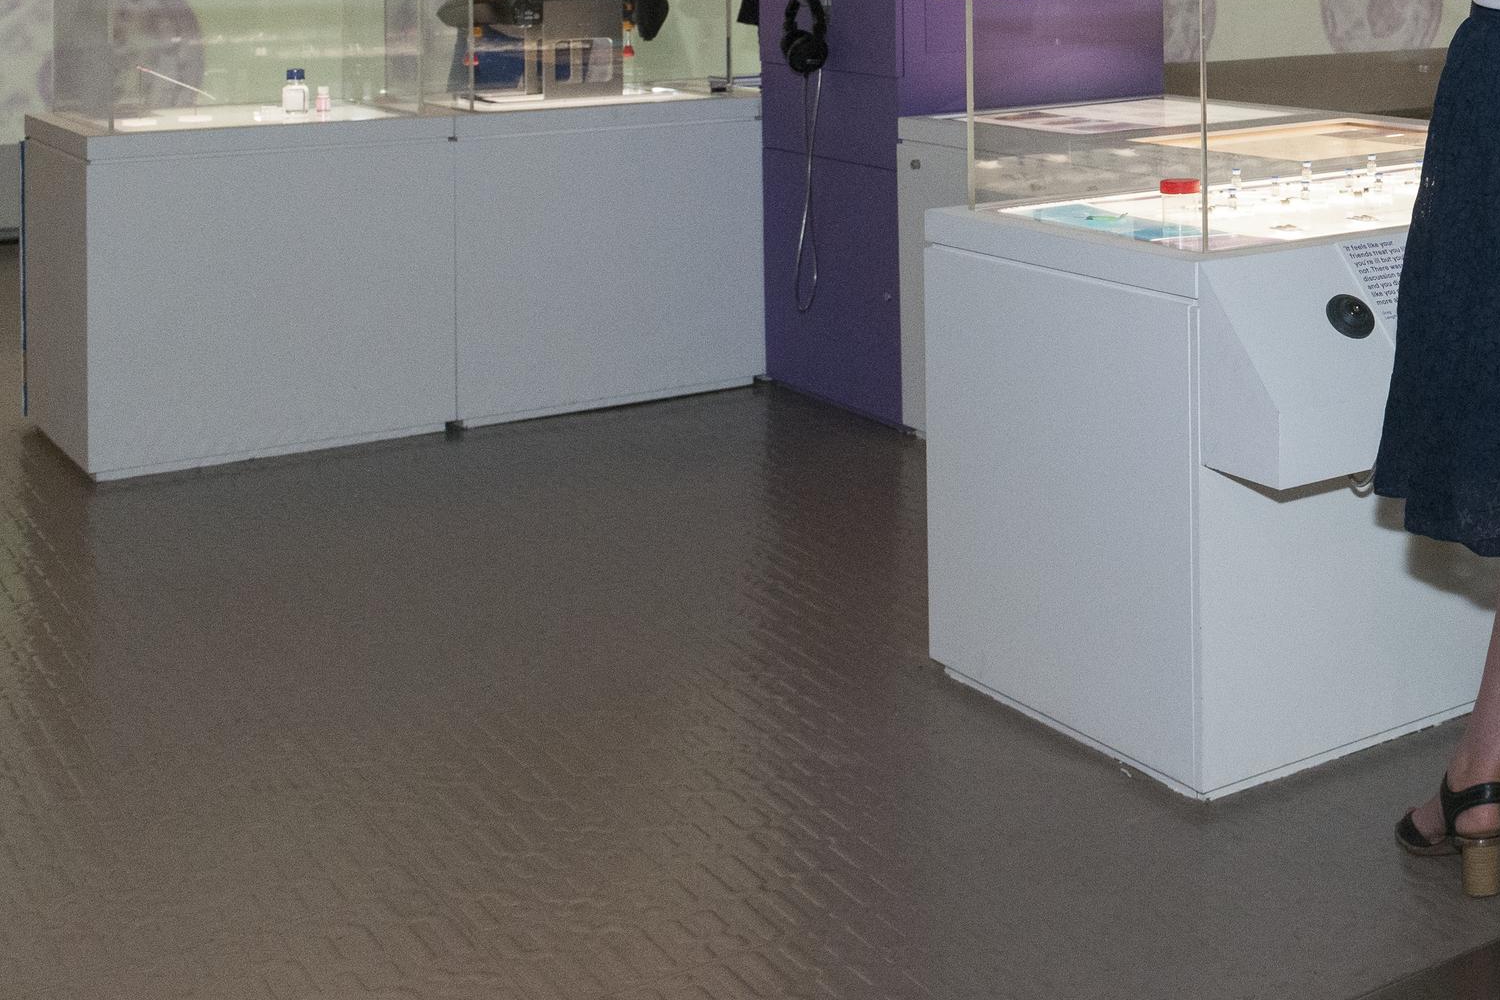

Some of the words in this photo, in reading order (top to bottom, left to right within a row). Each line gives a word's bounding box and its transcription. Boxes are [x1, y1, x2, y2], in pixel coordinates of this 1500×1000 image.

[1351, 243, 1367, 251] feels
[1380, 241, 1392, 249] your
[1349, 251, 1372, 259] friends
[1389, 247, 1400, 255] you
[1363, 273, 1396, 282] discussion
